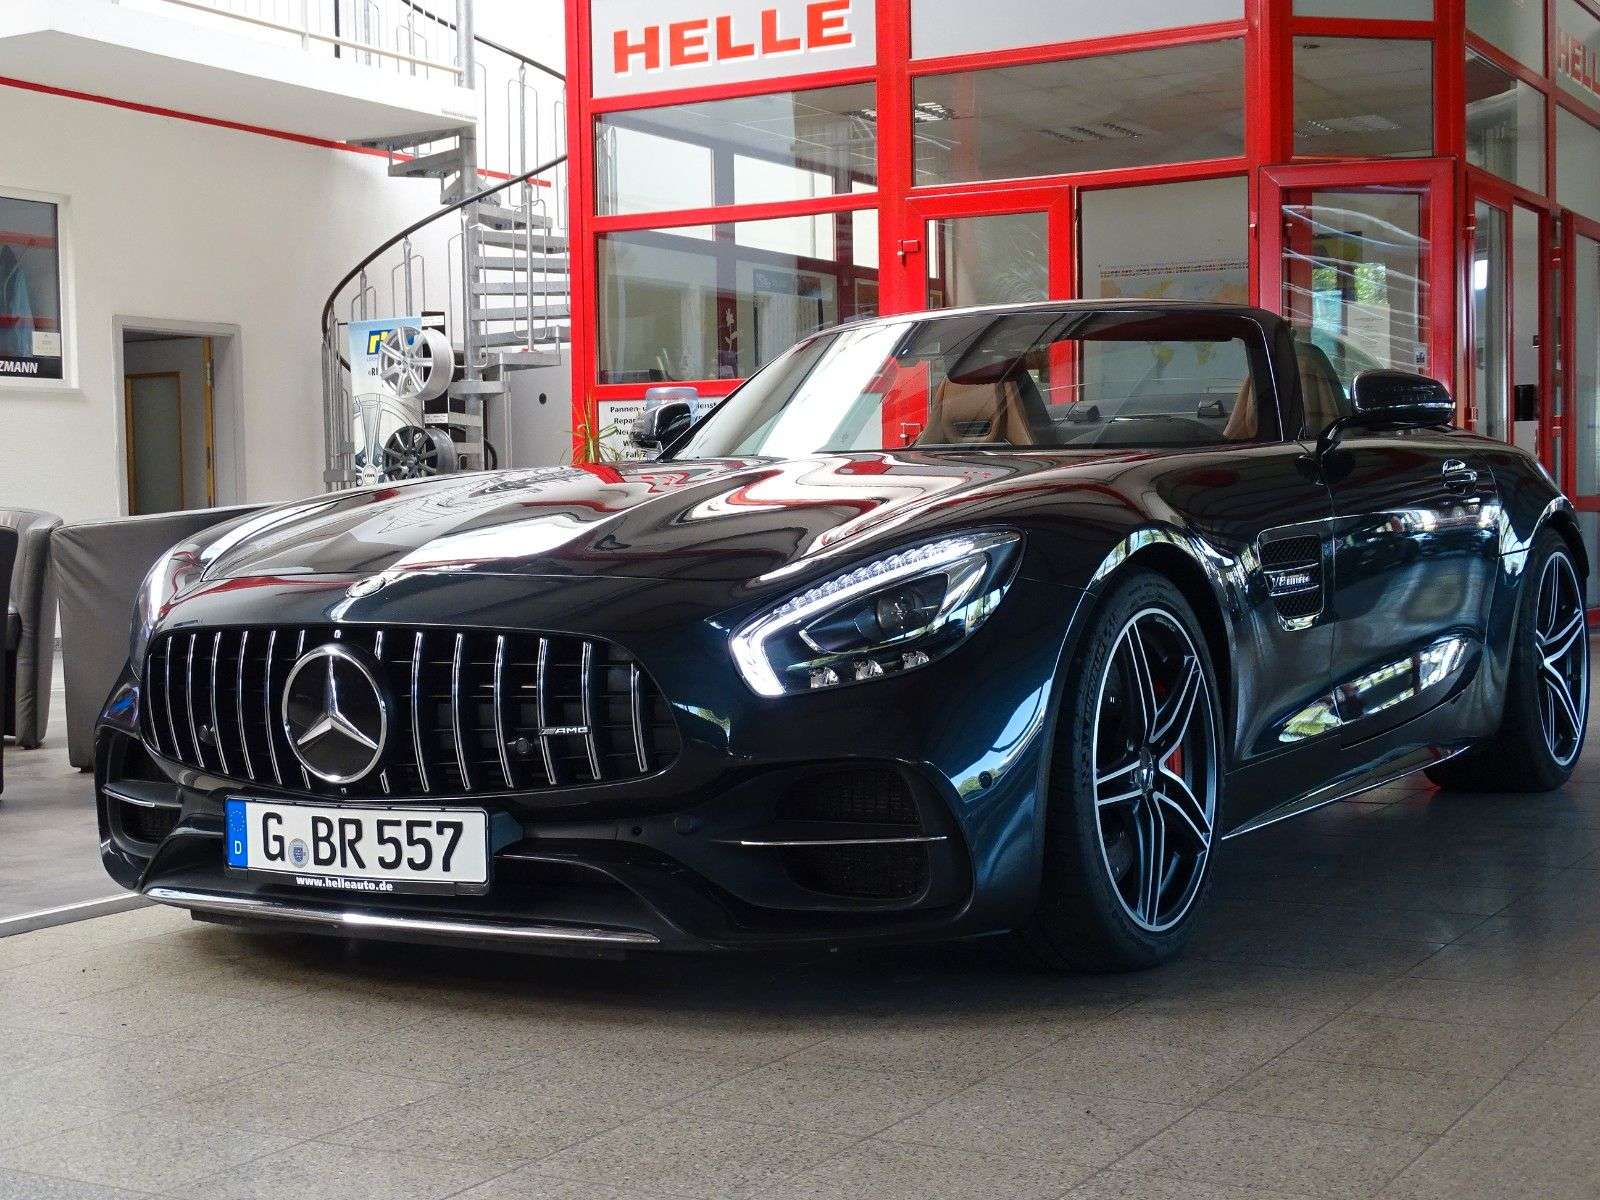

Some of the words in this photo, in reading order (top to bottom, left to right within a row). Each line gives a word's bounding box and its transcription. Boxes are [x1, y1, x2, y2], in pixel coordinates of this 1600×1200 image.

[613, 0, 853, 74] HELLE
[234, 840, 242, 855] D
[262, 811, 286, 862] G
[311, 815, 366, 869] BR
[376, 818, 464, 872] 557
[296, 875, 393, 892] www.helleauto.de
